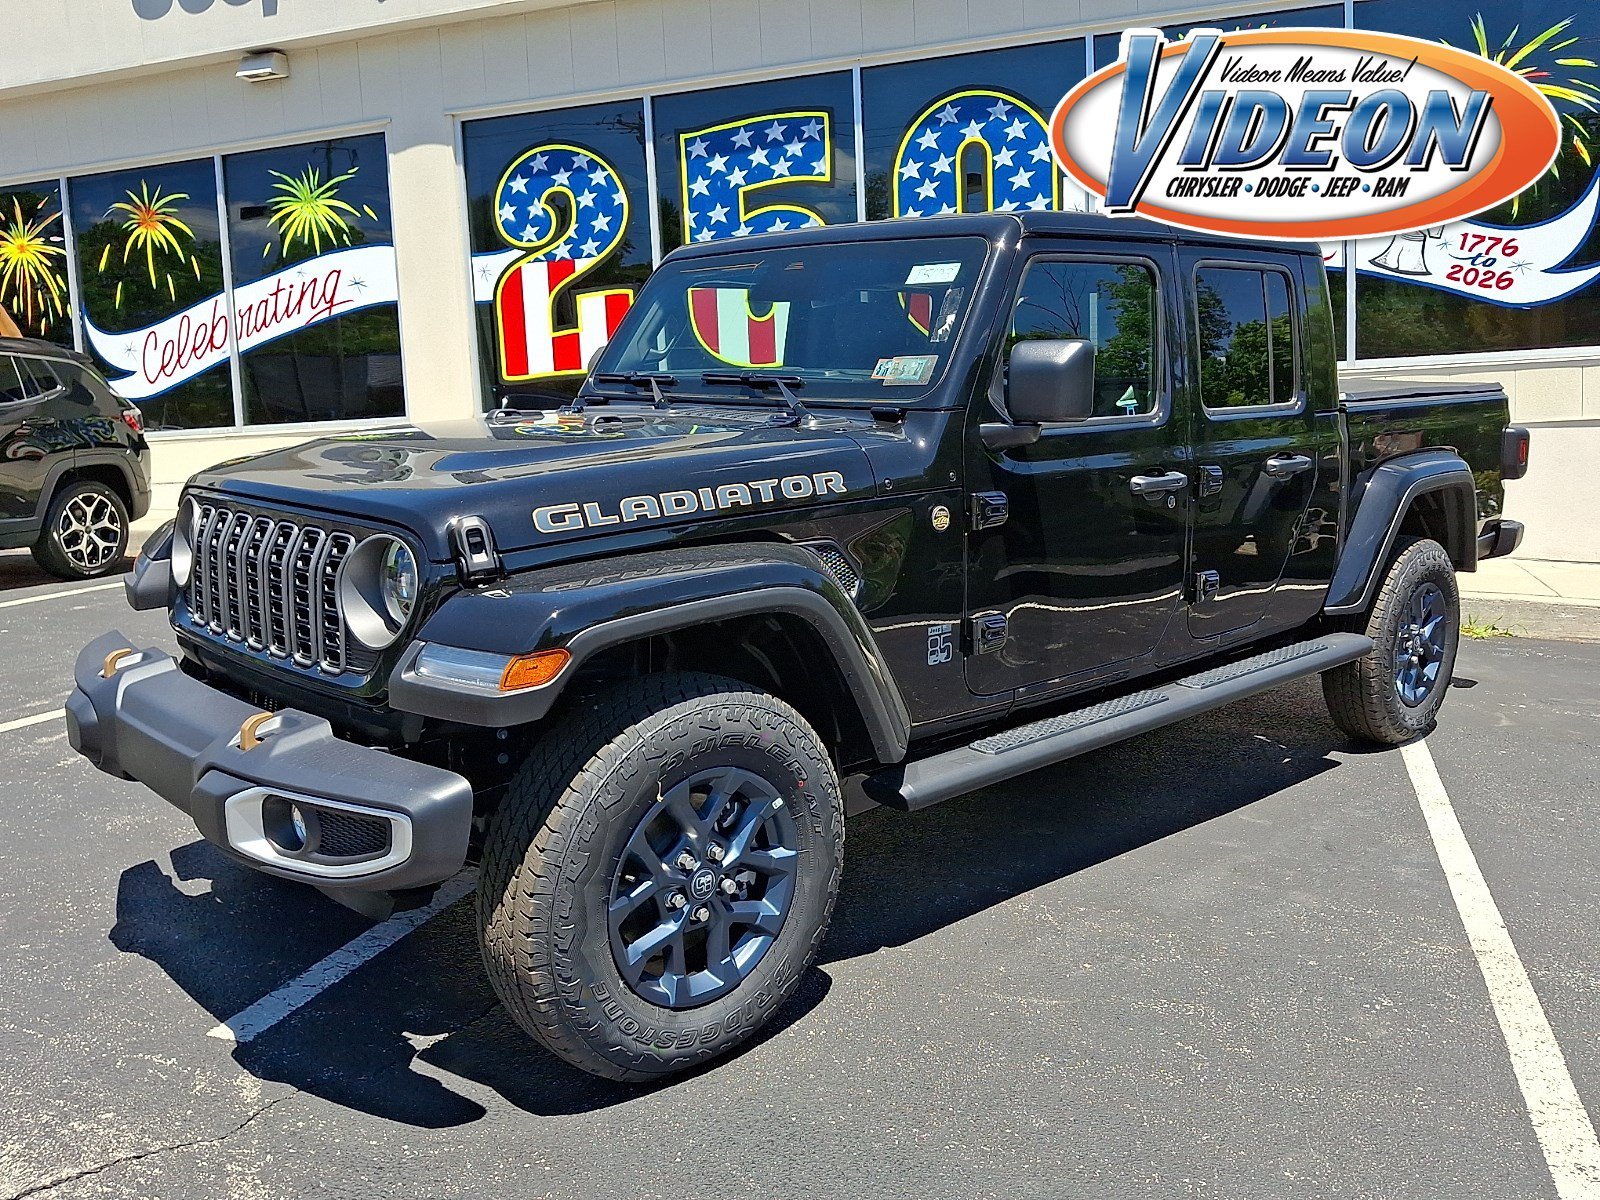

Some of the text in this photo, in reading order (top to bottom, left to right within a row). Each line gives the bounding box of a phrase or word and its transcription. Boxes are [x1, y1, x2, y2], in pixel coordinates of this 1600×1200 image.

[1448, 253, 1497, 267] to
[1460, 232, 1519, 257] 1776
[1446, 264, 1514, 290] 2026
[143, 269, 354, 384] Celebrating
[531, 471, 847, 533] GLADIATOR
[928, 633, 952, 666] 85
[590, 954, 792, 1050] BRIDGESTONE
